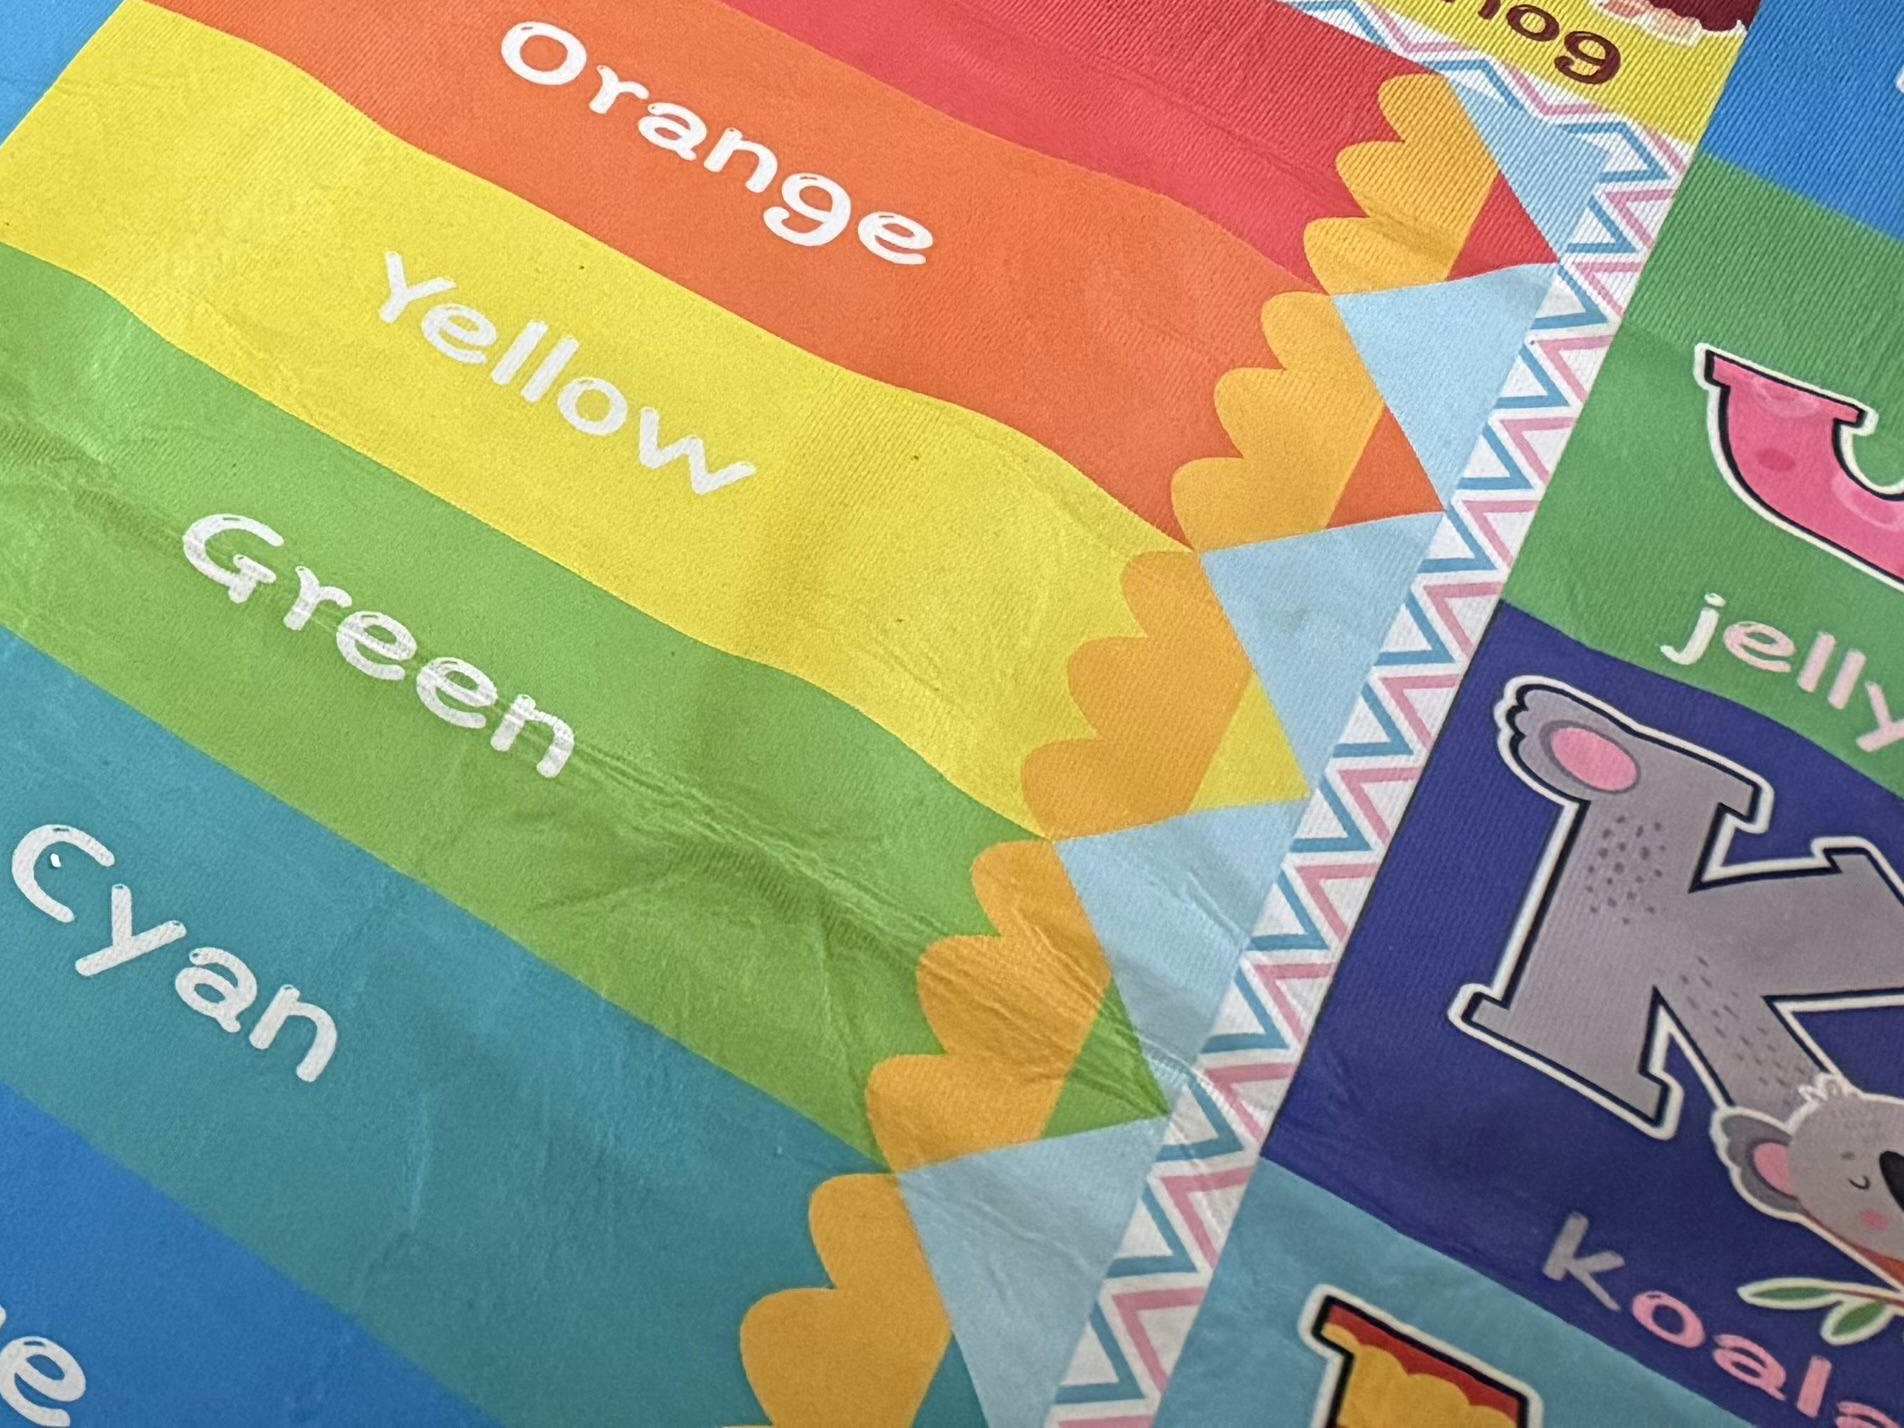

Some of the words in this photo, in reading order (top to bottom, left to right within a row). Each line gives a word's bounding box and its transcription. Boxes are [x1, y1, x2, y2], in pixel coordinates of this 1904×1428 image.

[499, 18, 937, 271] Orange
[377, 249, 757, 498] Yellow
[180, 508, 579, 779] Green
[9, 822, 341, 1085] Cyan
